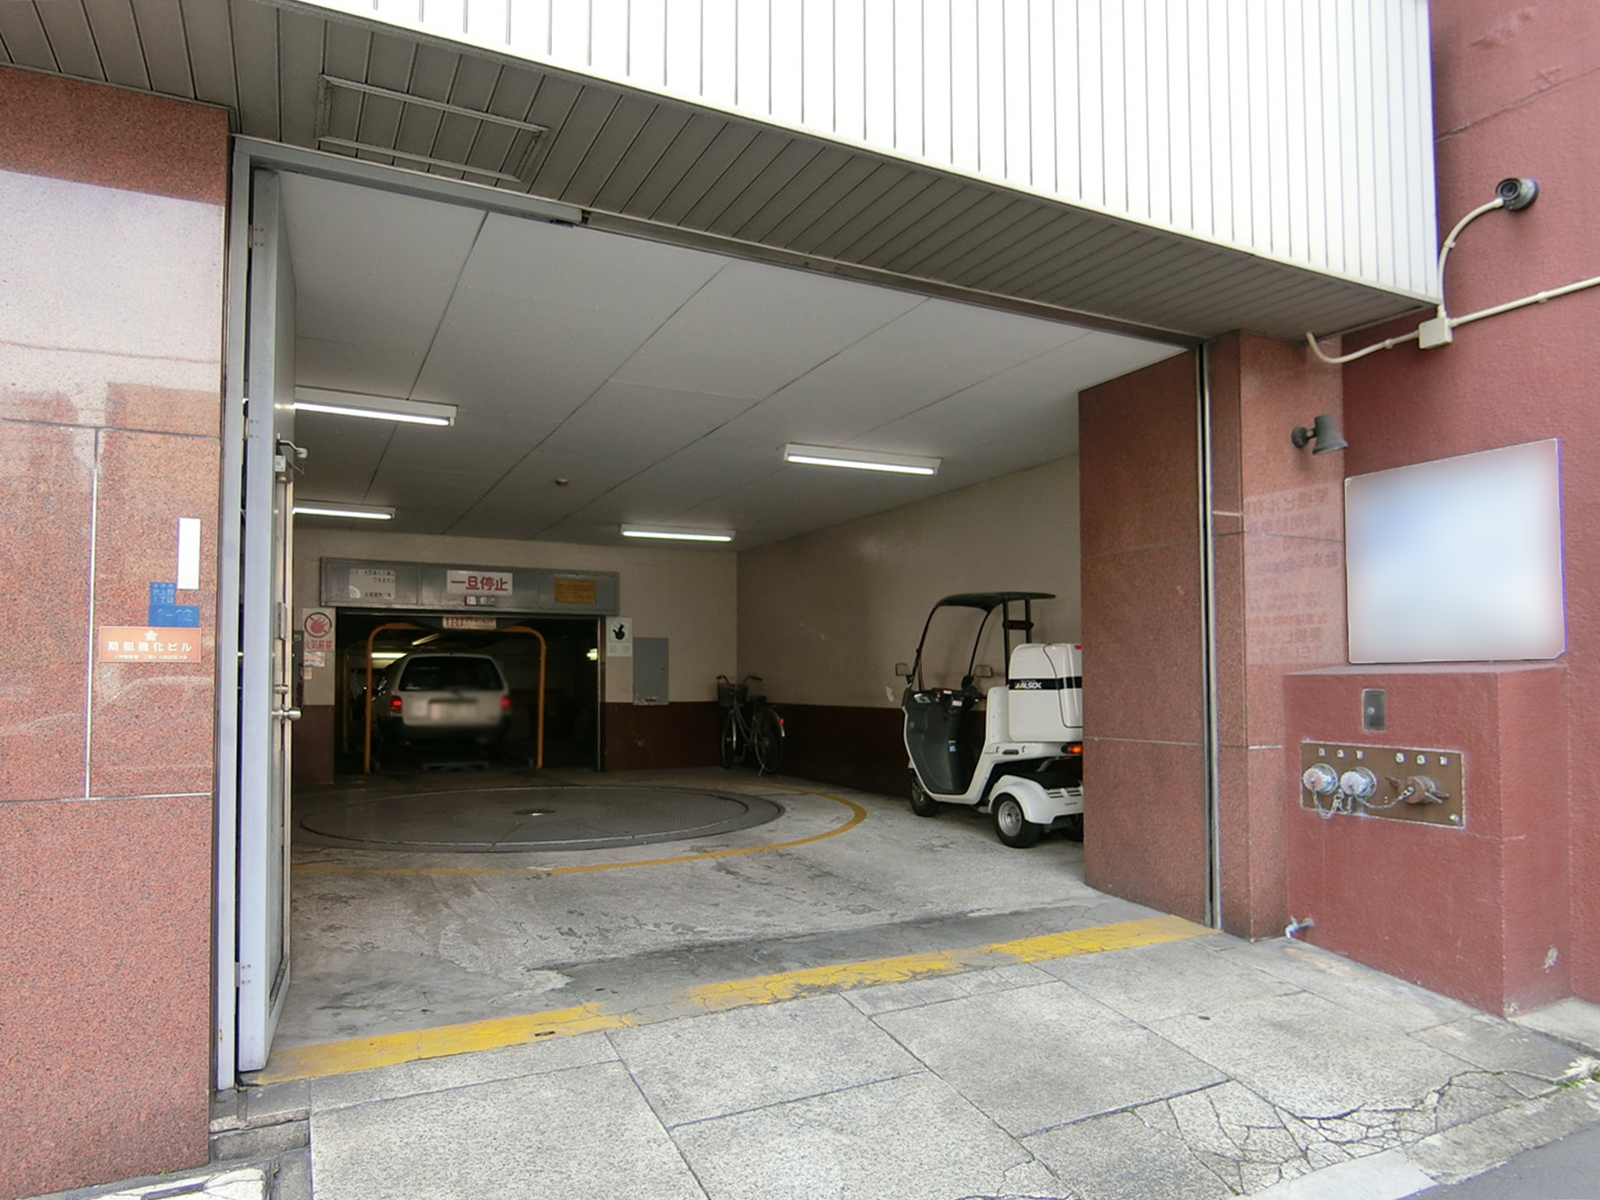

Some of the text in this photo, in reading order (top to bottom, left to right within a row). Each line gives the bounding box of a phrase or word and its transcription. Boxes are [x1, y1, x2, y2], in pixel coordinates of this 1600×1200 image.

[451, 576, 509, 591] 一旦停止
[107, 641, 193, 652] 防犯強化ビル
